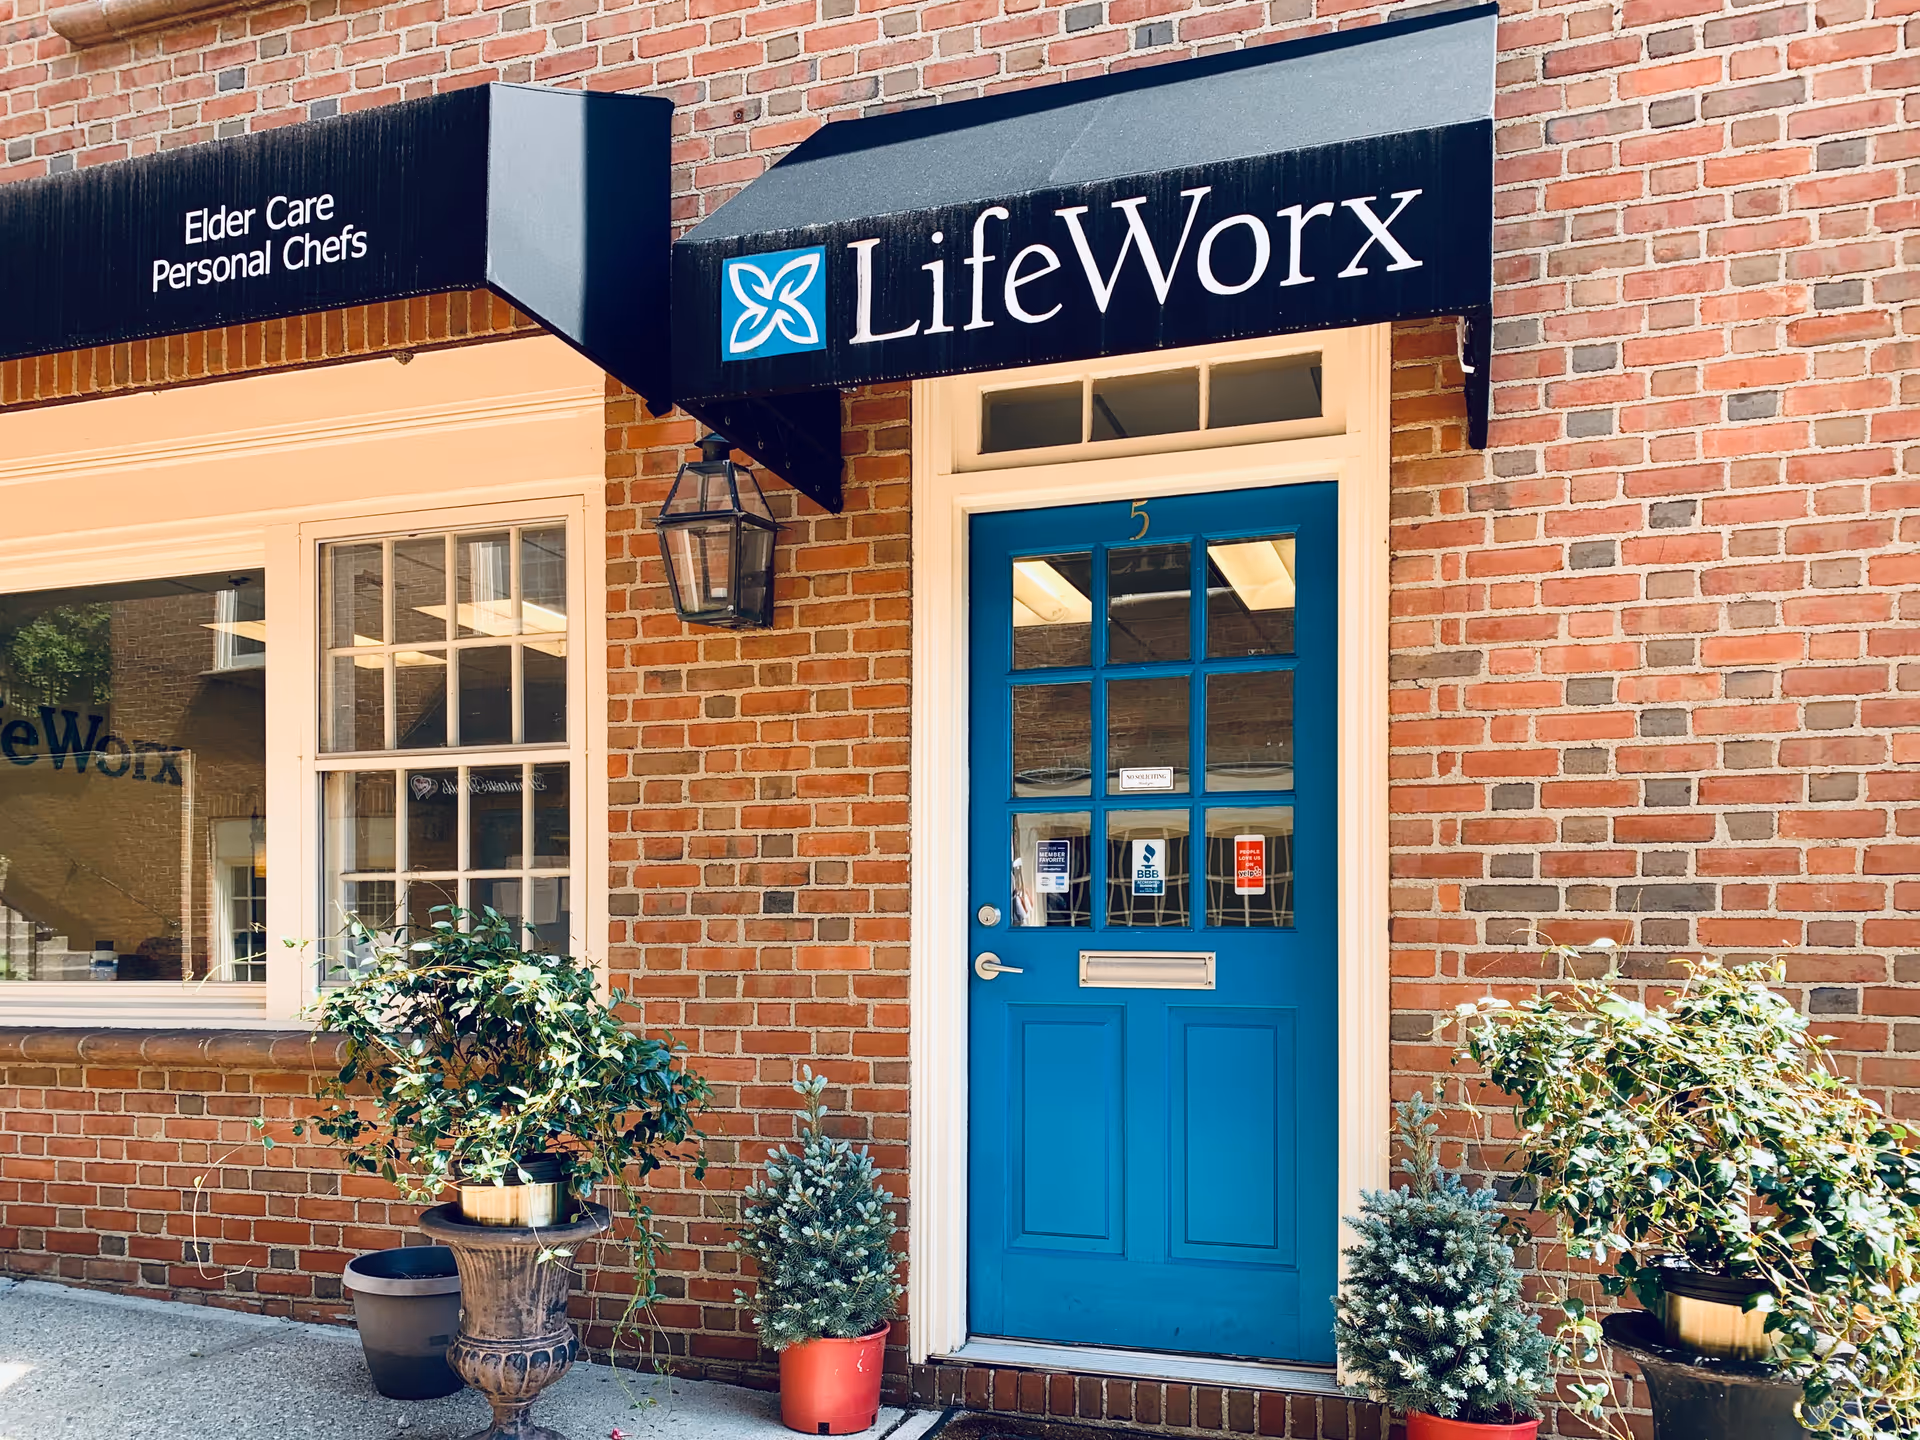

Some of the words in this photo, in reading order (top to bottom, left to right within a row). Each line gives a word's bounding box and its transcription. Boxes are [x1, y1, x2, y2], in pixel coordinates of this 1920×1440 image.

[185, 204, 256, 245] Elder
[266, 193, 335, 231] Care
[152, 240, 272, 293] Personal
[283, 224, 368, 271] Chefs
[847, 185, 1424, 346] LifeWorx
[1129, 499, 1150, 541] 5
[0, 698, 186, 786] eWorx
[1137, 869, 1159, 879] BBB
[1238, 869, 1256, 879] yelp
